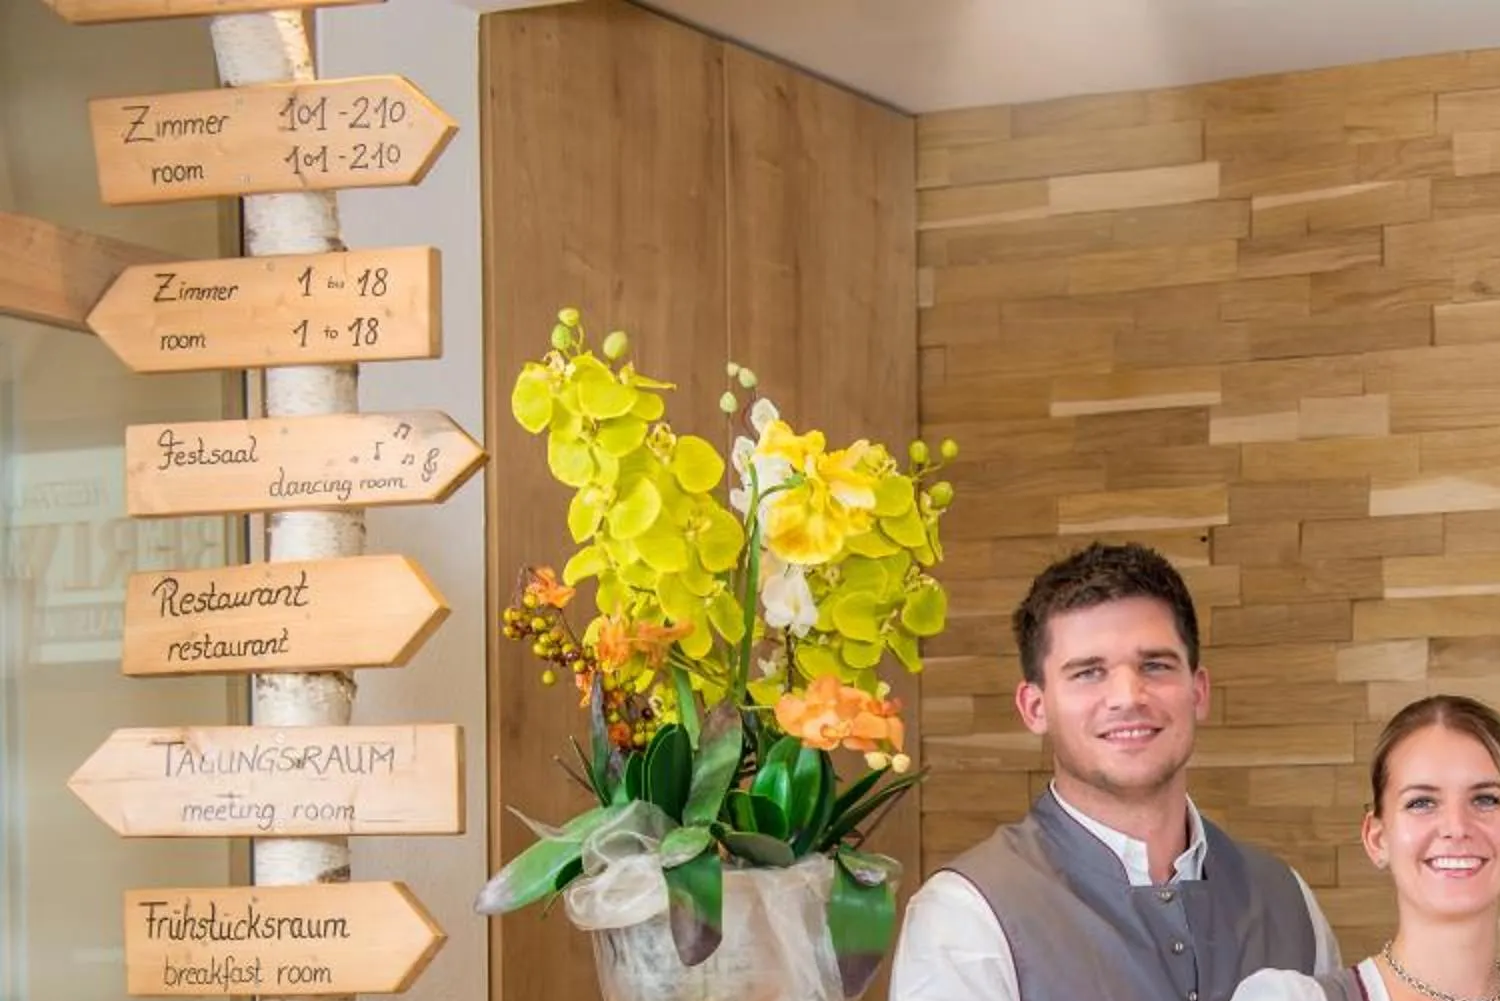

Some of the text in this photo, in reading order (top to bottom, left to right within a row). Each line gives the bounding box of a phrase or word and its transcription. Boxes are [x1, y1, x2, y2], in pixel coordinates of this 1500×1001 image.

[121, 105, 230, 144] Zimmer
[152, 163, 204, 184] room
[153, 273, 239, 303] Zimmer
[297, 266, 313, 296] 1
[357, 267, 389, 297] 18
[160, 317, 379, 350] room 1 to 18
[157, 429, 259, 471] Festsaal
[269, 468, 407, 501] dancing room
[151, 570, 310, 618] Restaurant
[167, 627, 289, 662] restaurant
[181, 797, 357, 831] meeting room
[138, 901, 351, 941] Frühstücksraum
[163, 955, 333, 993] breakfast room
